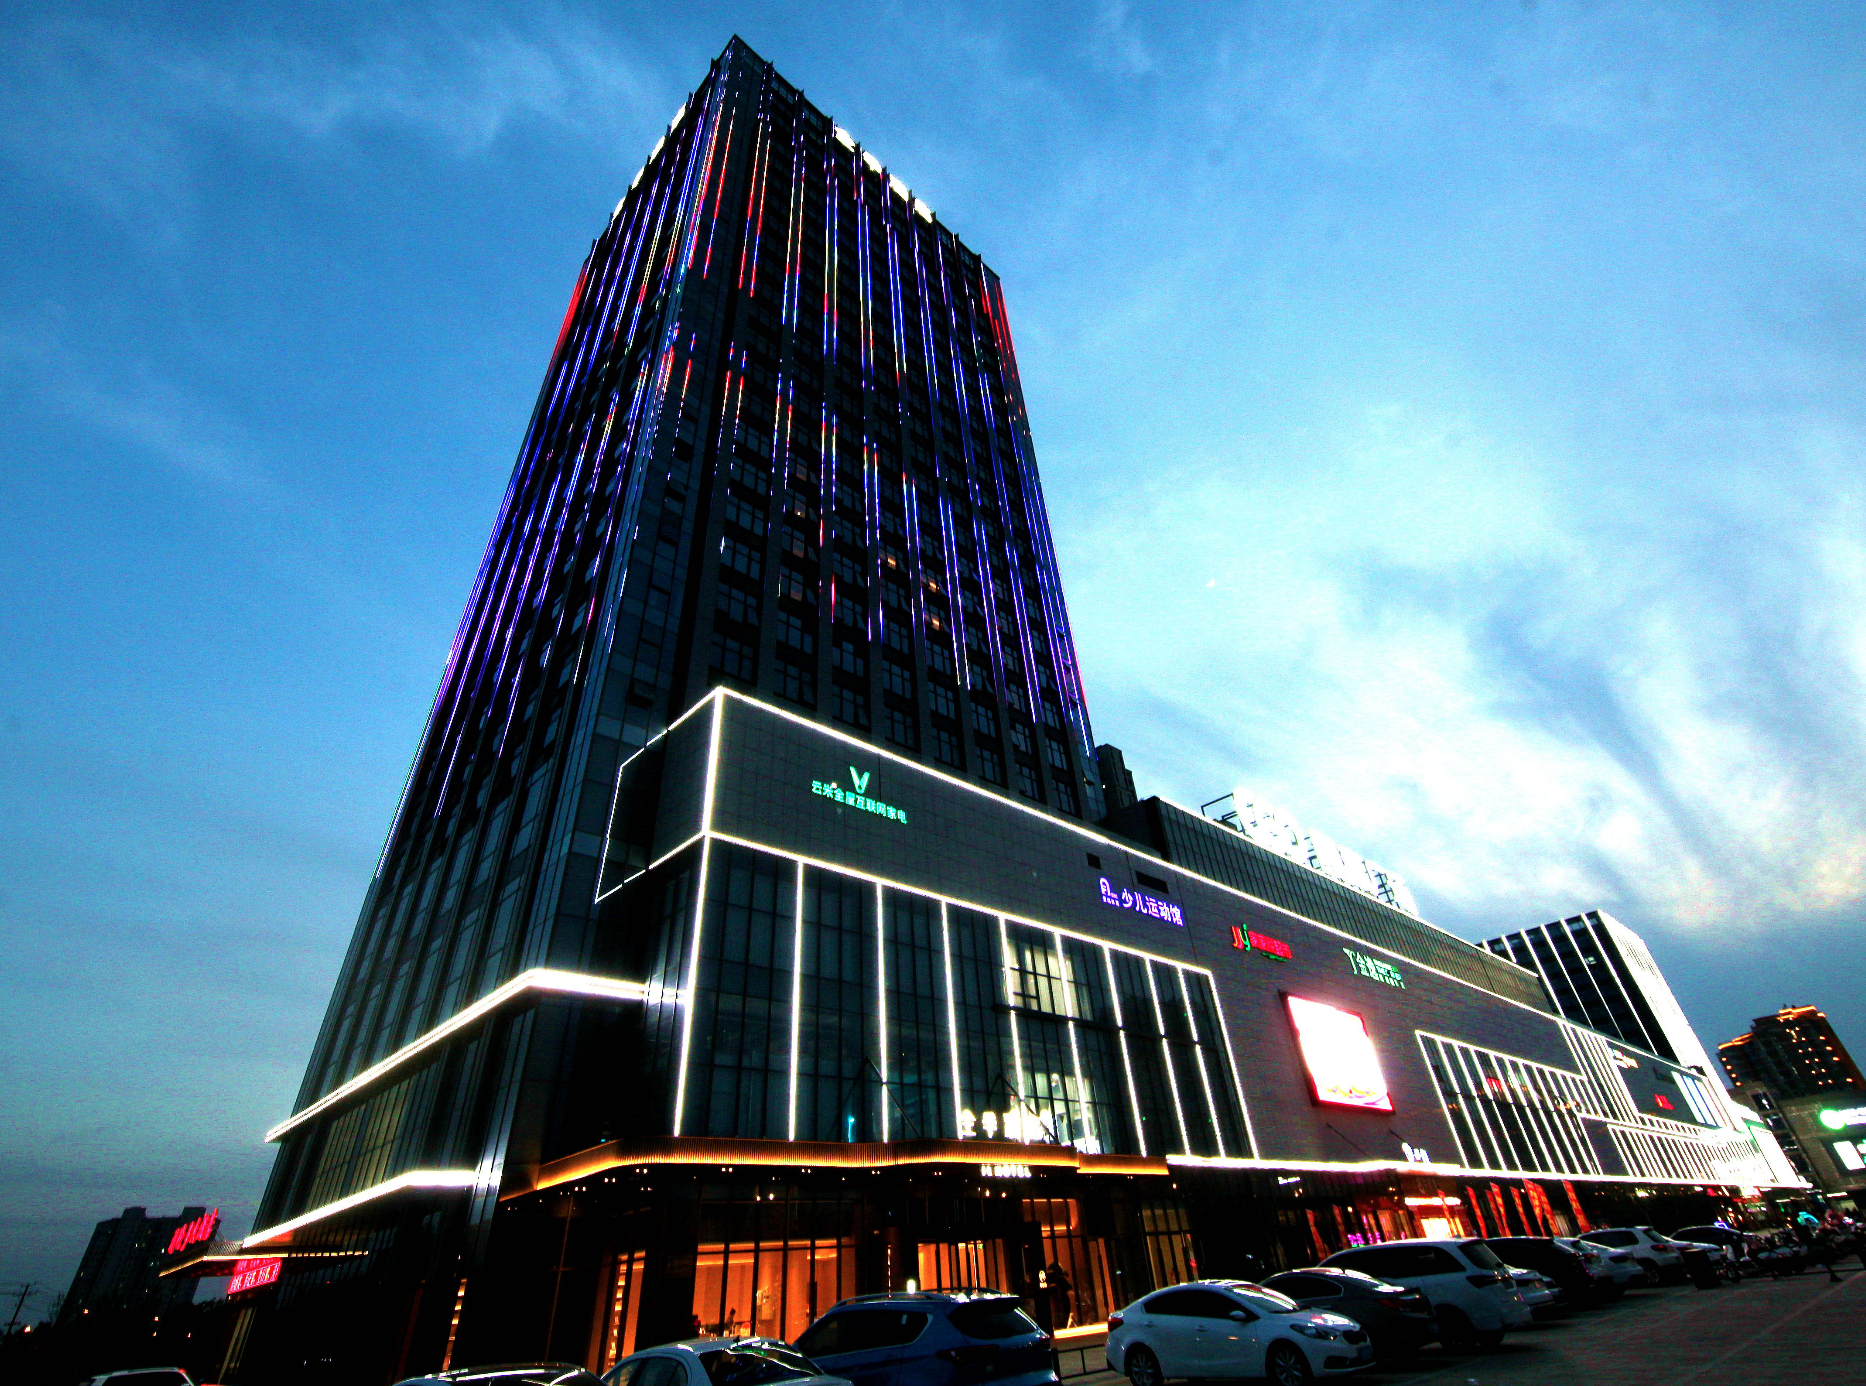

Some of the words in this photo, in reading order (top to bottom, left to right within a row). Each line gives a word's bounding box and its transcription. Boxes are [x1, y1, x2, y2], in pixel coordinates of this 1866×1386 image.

[811, 780, 908, 825] 云米全屋互联网家电
[1121, 888, 1184, 927] 少儿运动馆
